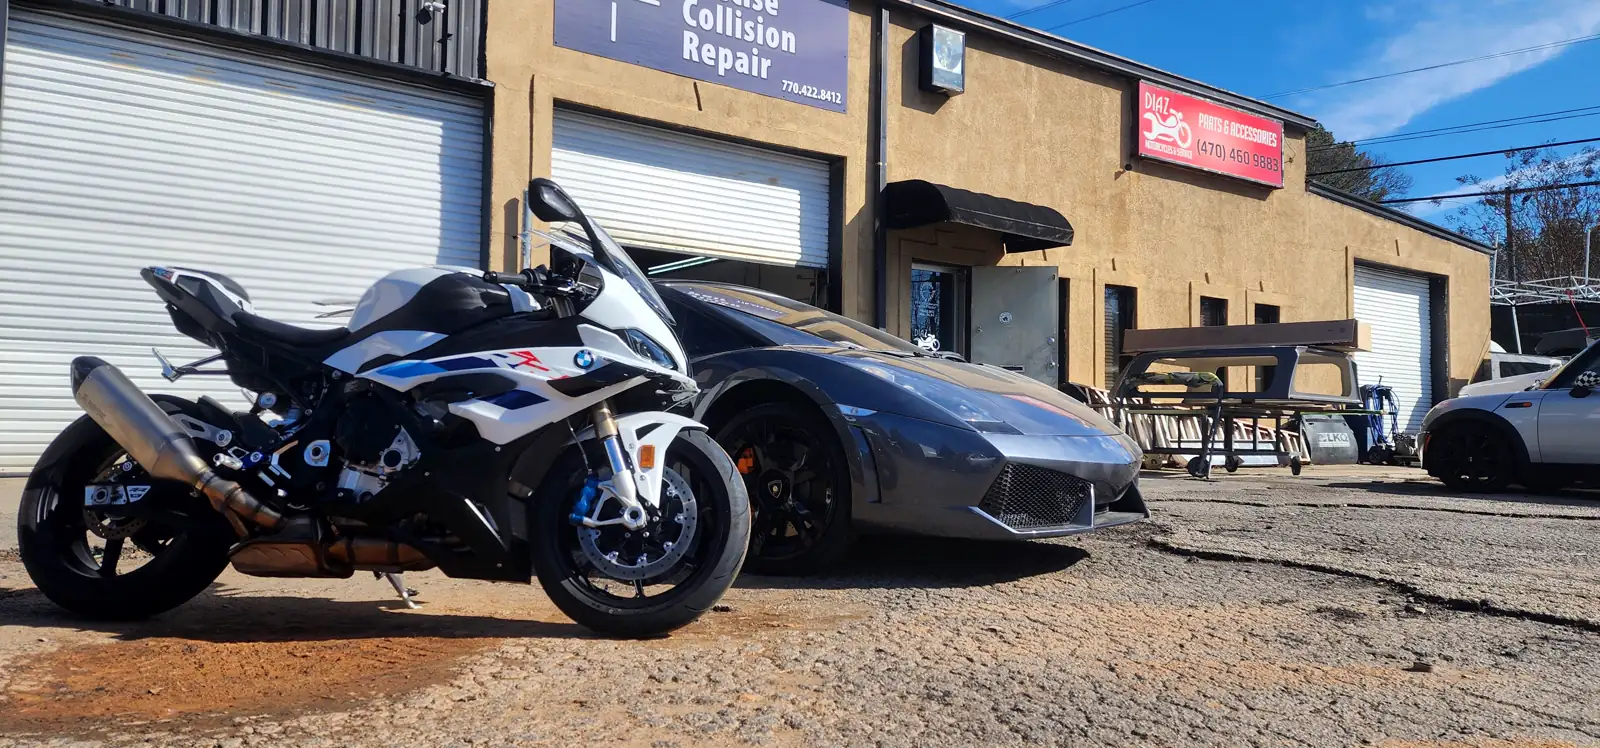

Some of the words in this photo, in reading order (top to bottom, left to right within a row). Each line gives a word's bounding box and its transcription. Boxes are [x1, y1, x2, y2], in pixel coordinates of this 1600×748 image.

[682, 0, 796, 54] Collision
[682, 30, 772, 79] Repair
[781, 79, 842, 104] 770.422.8412
[1145, 91, 1170, 115] DIAZ
[1198, 112, 1222, 133] PARTS
[1223, 120, 1229, 135] &
[1230, 122, 1277, 148] ACCESSORIES
[1196, 138, 1226, 162] (470)
[1229, 147, 1250, 165] 460
[1252, 153, 1279, 172] 9883
[1327, 433, 1349, 442] LKQ
